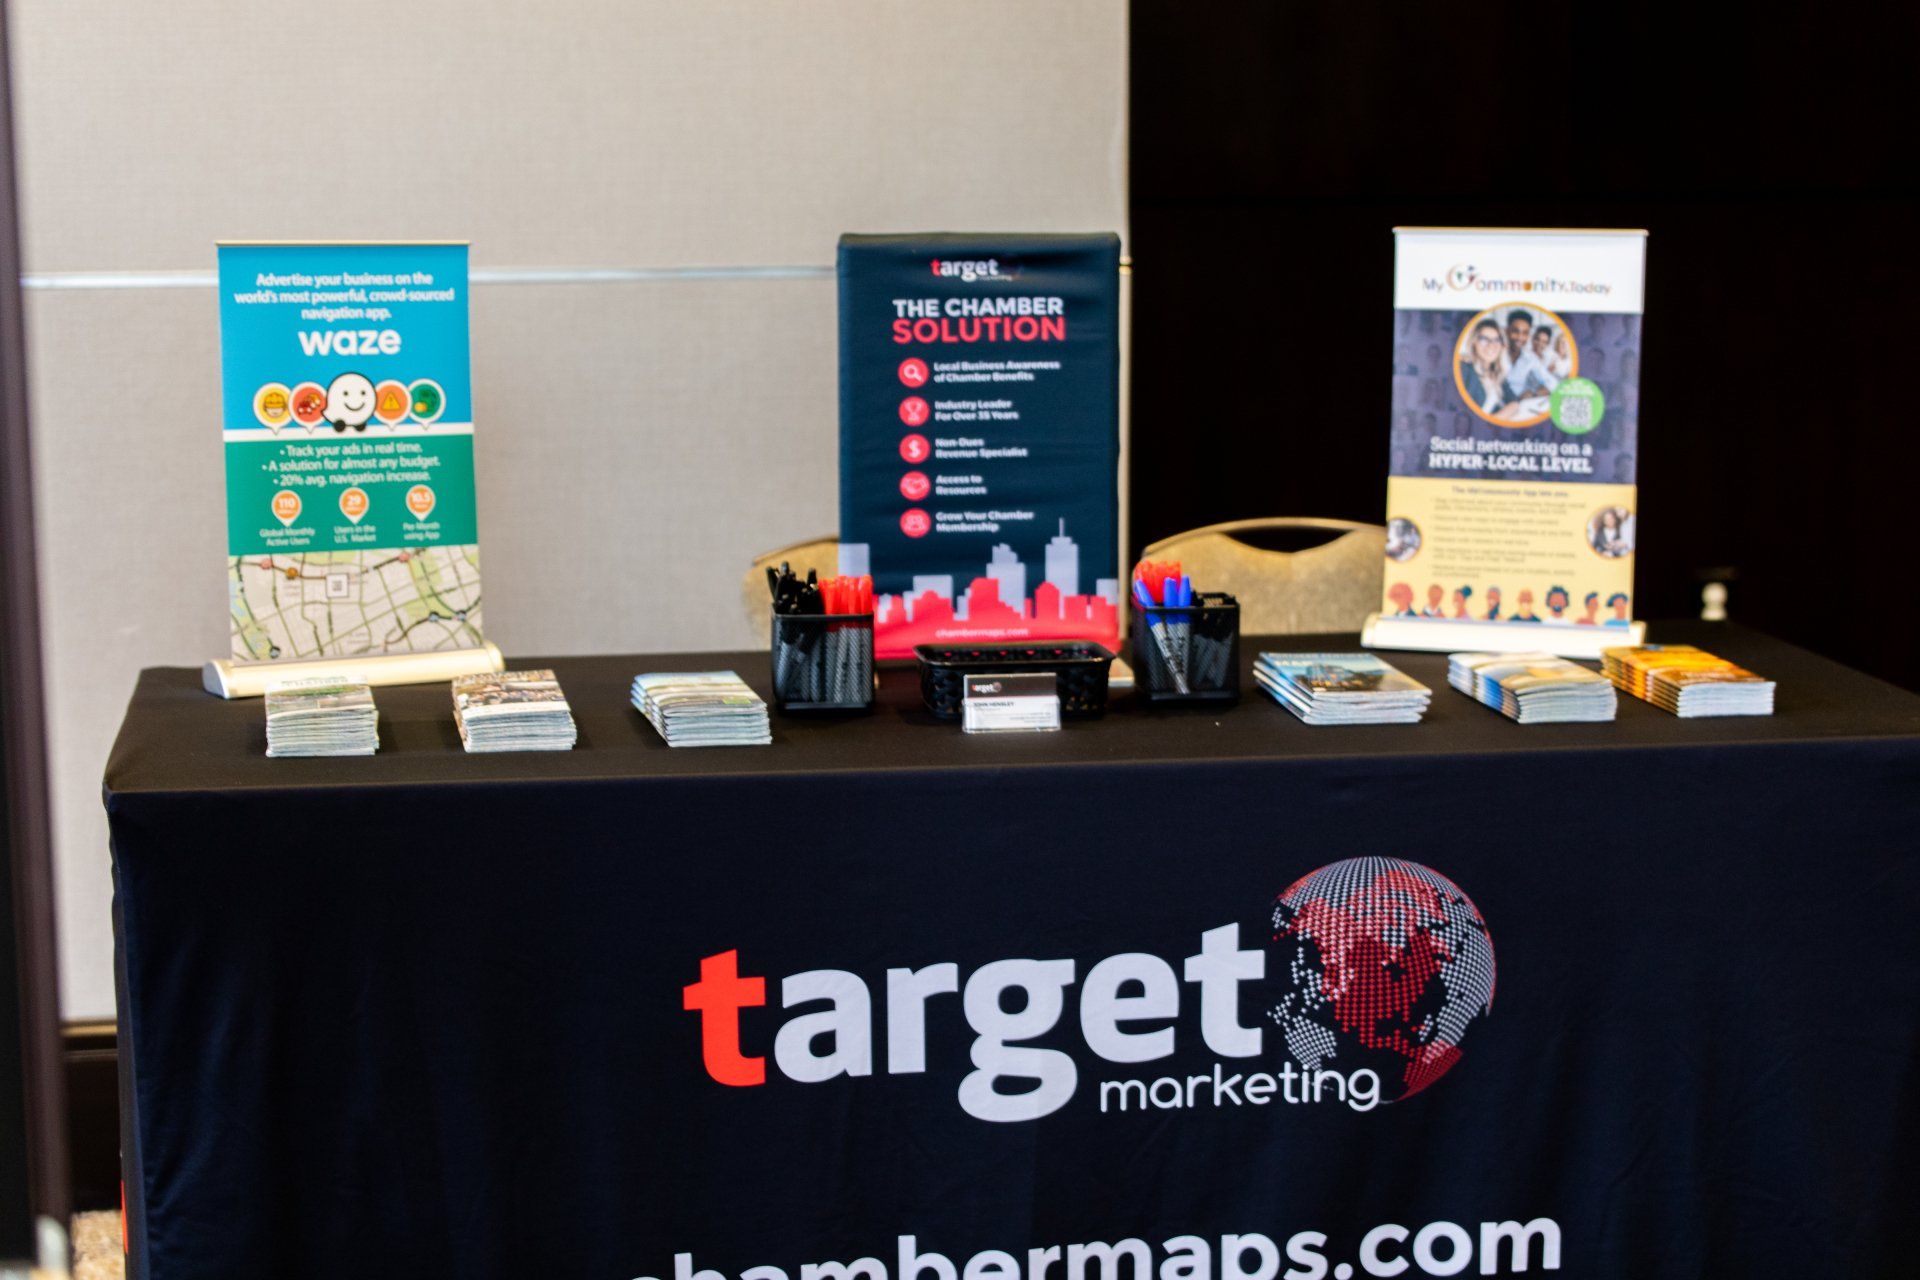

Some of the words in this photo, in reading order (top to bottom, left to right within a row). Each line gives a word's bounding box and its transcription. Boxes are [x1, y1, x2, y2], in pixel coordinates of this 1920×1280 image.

[930, 258, 999, 283] target
[256, 273, 313, 286] Advertise
[314, 275, 341, 288] your
[344, 272, 393, 286] business
[396, 274, 410, 285] on
[413, 272, 433, 284] the
[234, 290, 278, 304] world's
[280, 291, 310, 303] most
[312, 289, 368, 305] powerful,
[369, 288, 455, 302] crowd-sourced
[301, 307, 363, 322] navigation
[366, 309, 392, 321] app.
[893, 298, 940, 318] THE
[944, 296, 1064, 316] CHAMBER
[892, 316, 1066, 344] SOLUTION
[298, 329, 402, 356] waze
[933, 361, 959, 372] Local
[960, 360, 1006, 372] Business
[1006, 359, 1062, 370] Awareness
[933, 372, 946, 383] of
[946, 372, 991, 382] Chamber
[992, 370, 1035, 382] Benefits
[934, 400, 976, 413] Industry
[978, 399, 1013, 410] Leader
[934, 412, 952, 422] For
[952, 411, 976, 422] Over
[992, 410, 1020, 421] Years
[934, 437, 985, 448] Non-Dues
[1429, 435, 1475, 452] Social
[1476, 438, 1558, 457] networking
[1559, 443, 1580, 456] on
[1581, 444, 1594, 457] a
[286, 444, 314, 456] Track
[316, 446, 341, 460] your
[342, 444, 361, 455] ads
[362, 443, 374, 454] in
[375, 442, 395, 454] real
[397, 442, 422, 454] time.
[935, 448, 978, 459] Revenue
[979, 446, 1029, 460] Specialist
[269, 460, 277, 472] A
[280, 458, 322, 471] solution
[324, 458, 340, 470] for
[342, 457, 377, 469] almost
[379, 458, 397, 471] any
[400, 456, 441, 468] budget.
[1428, 452, 1540, 472] HYPER-LOCAL
[1541, 456, 1594, 474] LEVEL
[280, 474, 304, 486] 20%
[330, 472, 384, 486] navigation
[386, 470, 431, 483] increase.
[935, 474, 970, 485] Access
[970, 474, 984, 484] to
[935, 484, 988, 496] Resources
[935, 510, 963, 522] Grow
[963, 510, 987, 522] Your
[988, 510, 1035, 521] Chamber
[935, 522, 1000, 534] Membership
[683, 922, 1266, 1123] target
[1100, 1061, 1381, 1113] marketing
[630, 1216, 1562, 1280] bermaps.com
